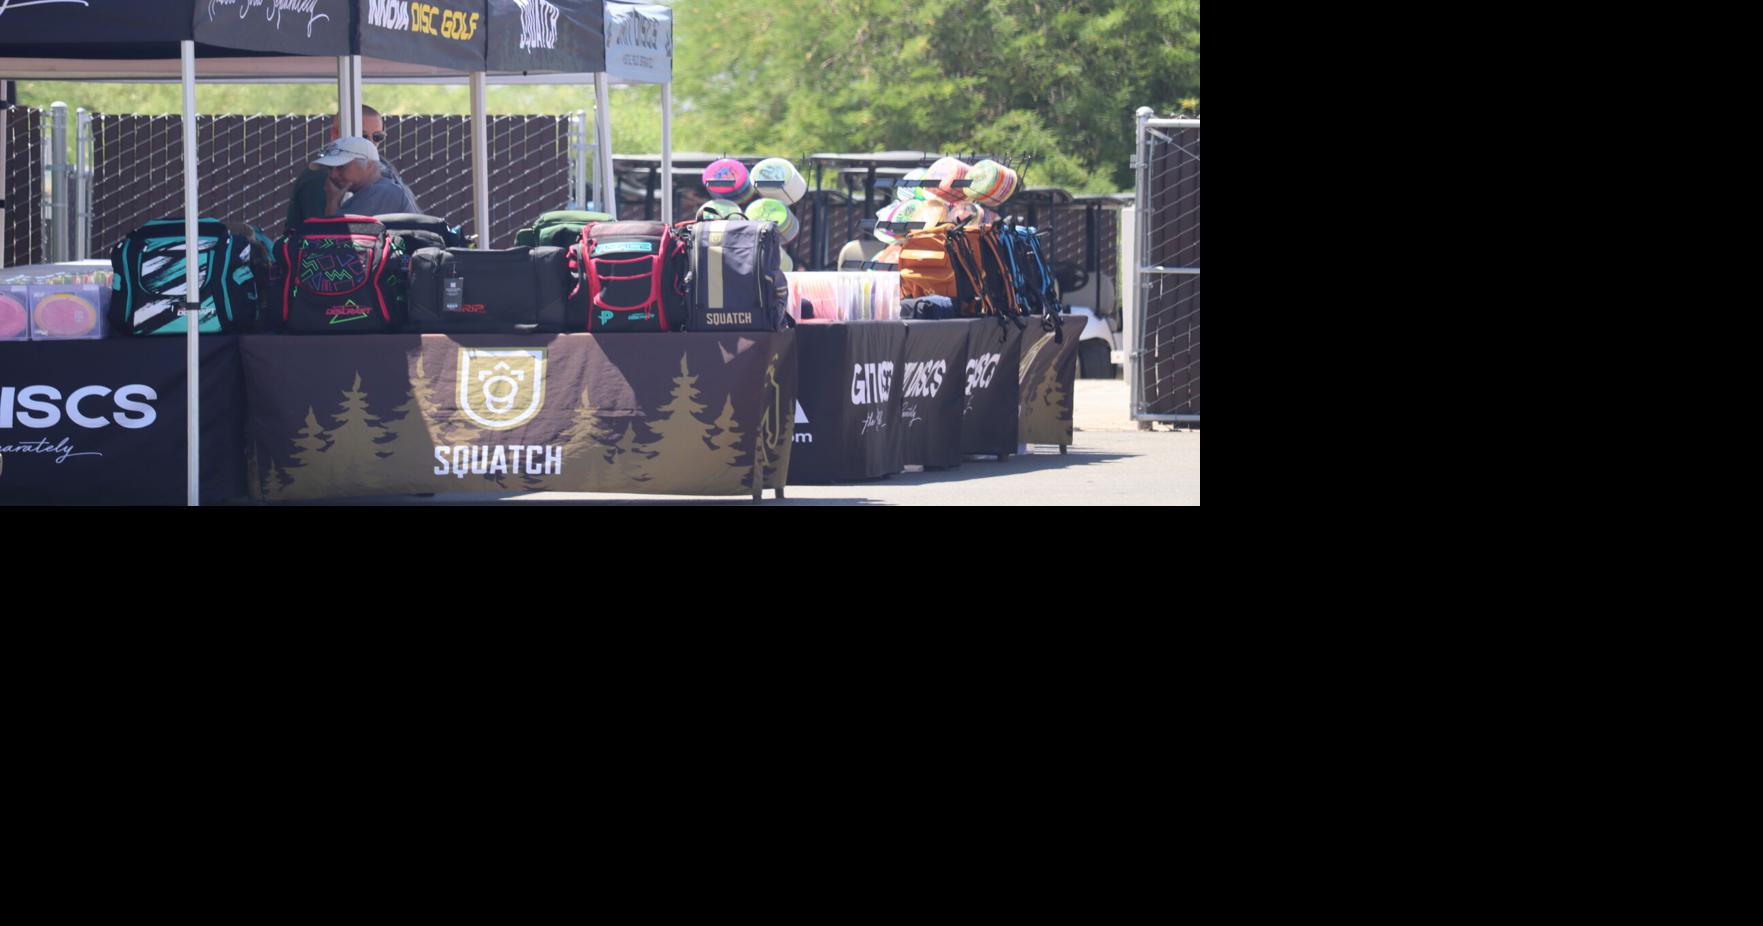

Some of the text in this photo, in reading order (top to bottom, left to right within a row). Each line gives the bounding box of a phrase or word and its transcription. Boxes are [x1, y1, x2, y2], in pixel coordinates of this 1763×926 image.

[411, 2, 439, 36] DISC
[441, 9, 479, 40] GOLF
[706, 312, 752, 325] SQUATCH
[0, 437, 103, 464] arately
[433, 445, 563, 478] SQUATCH
